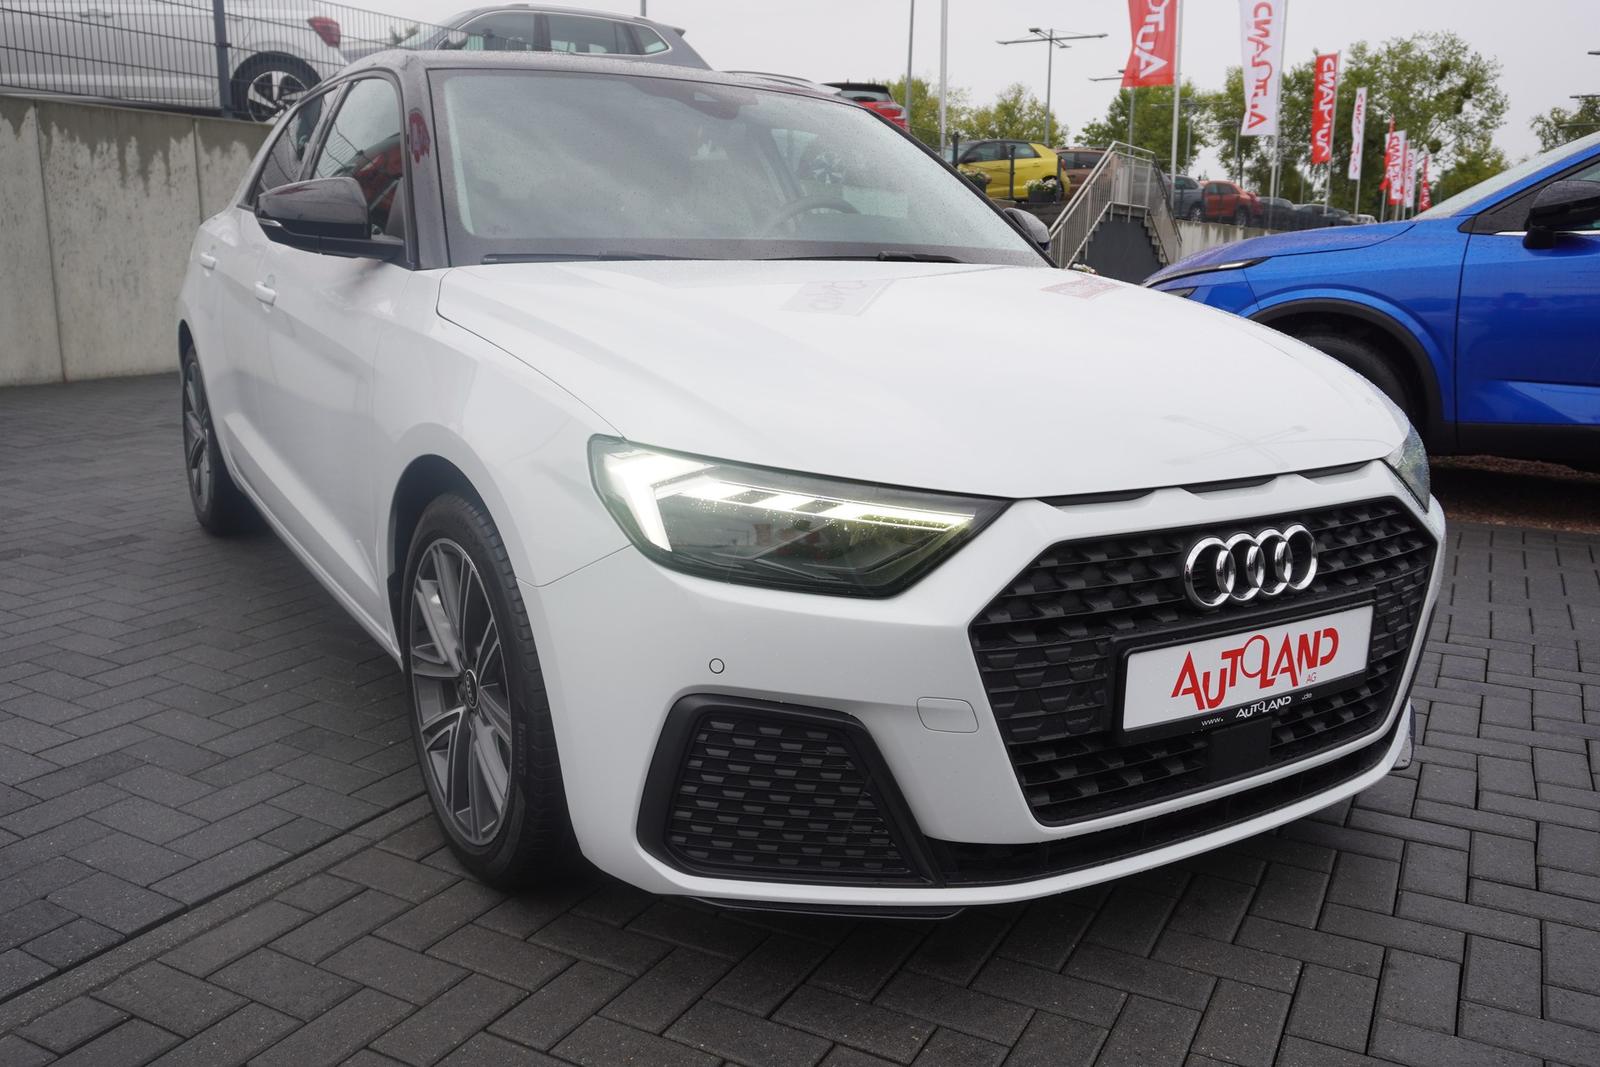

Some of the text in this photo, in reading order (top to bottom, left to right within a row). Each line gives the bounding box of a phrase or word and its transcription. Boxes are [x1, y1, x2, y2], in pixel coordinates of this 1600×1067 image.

[1171, 627, 1339, 711] AUTOLAND
[1305, 672, 1317, 685] AG
[1235, 695, 1292, 719] AUTOLAND
[1301, 692, 1313, 701] .de
